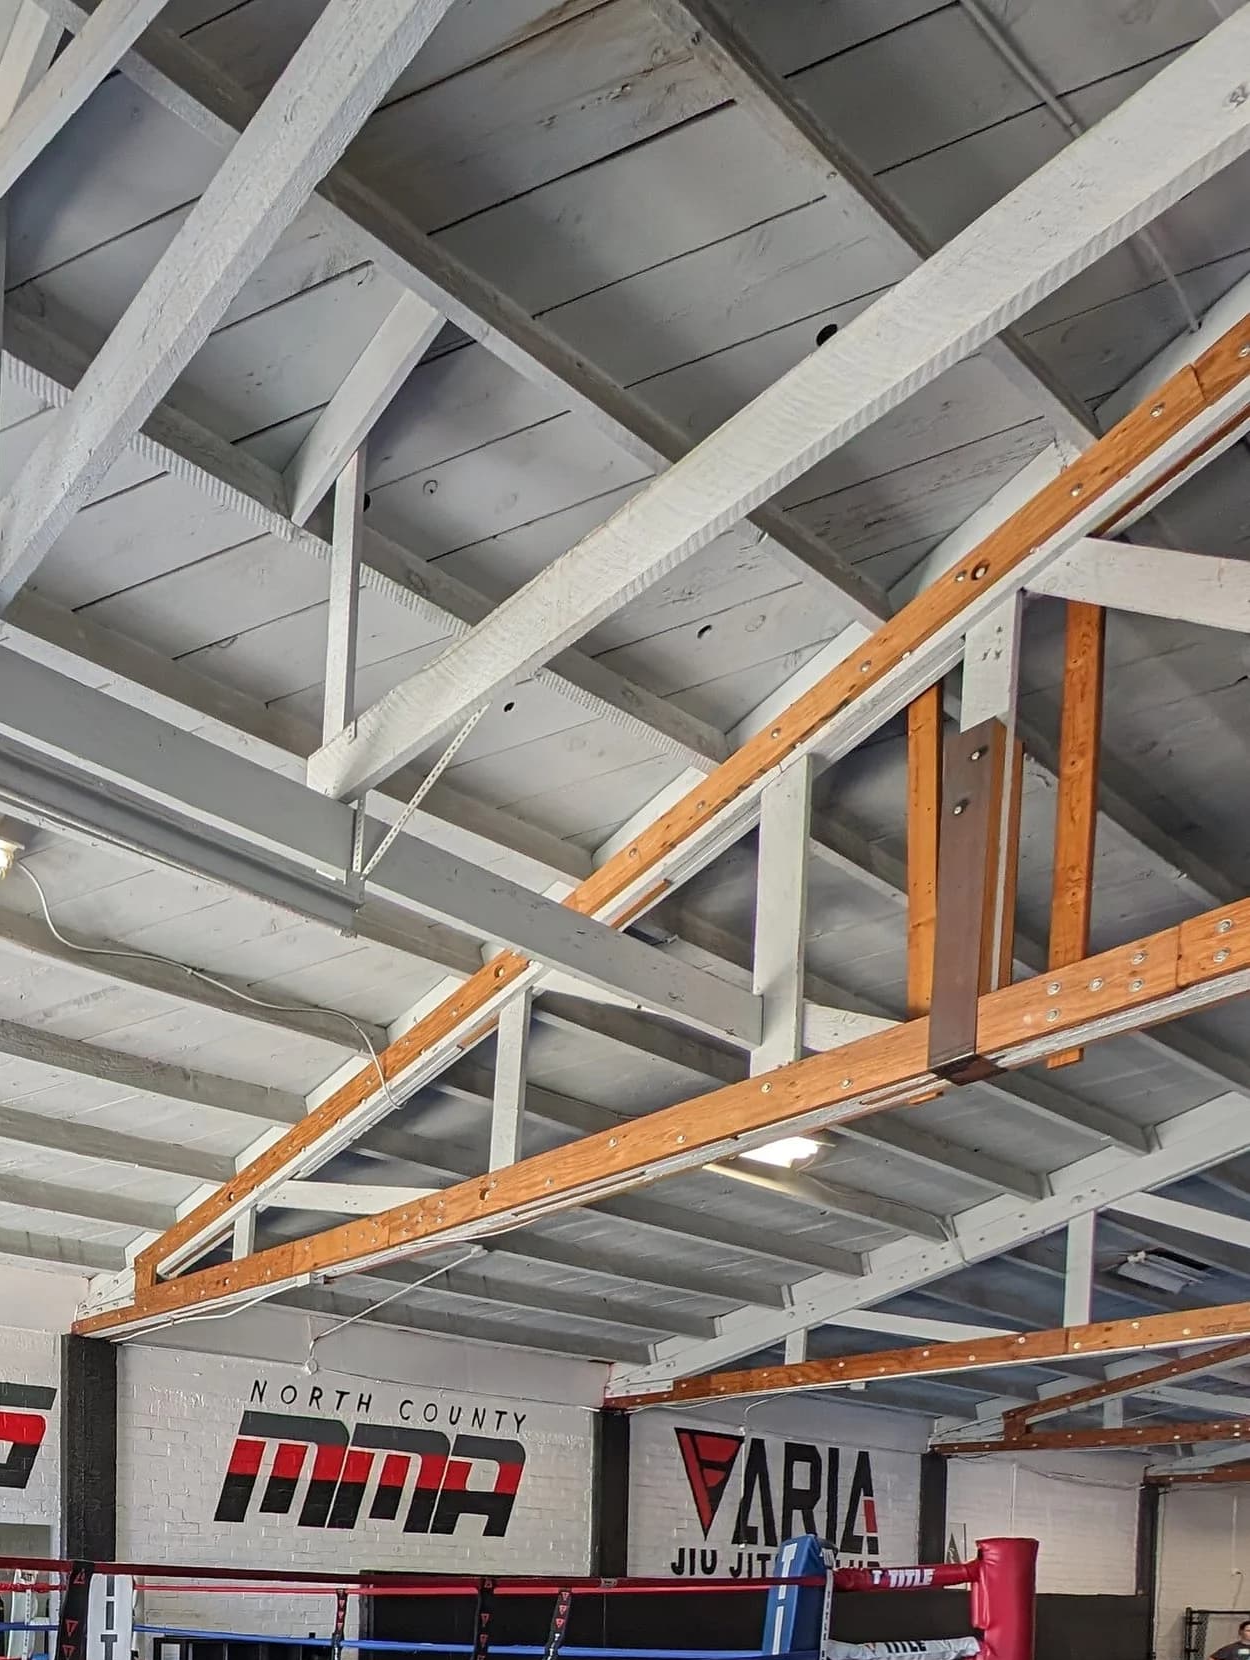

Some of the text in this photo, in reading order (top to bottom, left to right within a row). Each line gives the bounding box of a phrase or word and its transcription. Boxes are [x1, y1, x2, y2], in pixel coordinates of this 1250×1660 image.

[251, 1379, 529, 1435] NORTH COUNTY
[214, 1410, 526, 1538] MMA
[671, 1548, 717, 1576] JIU
[887, 1568, 936, 1588] TITLE
[885, 1641, 928, 1654] TITLE
